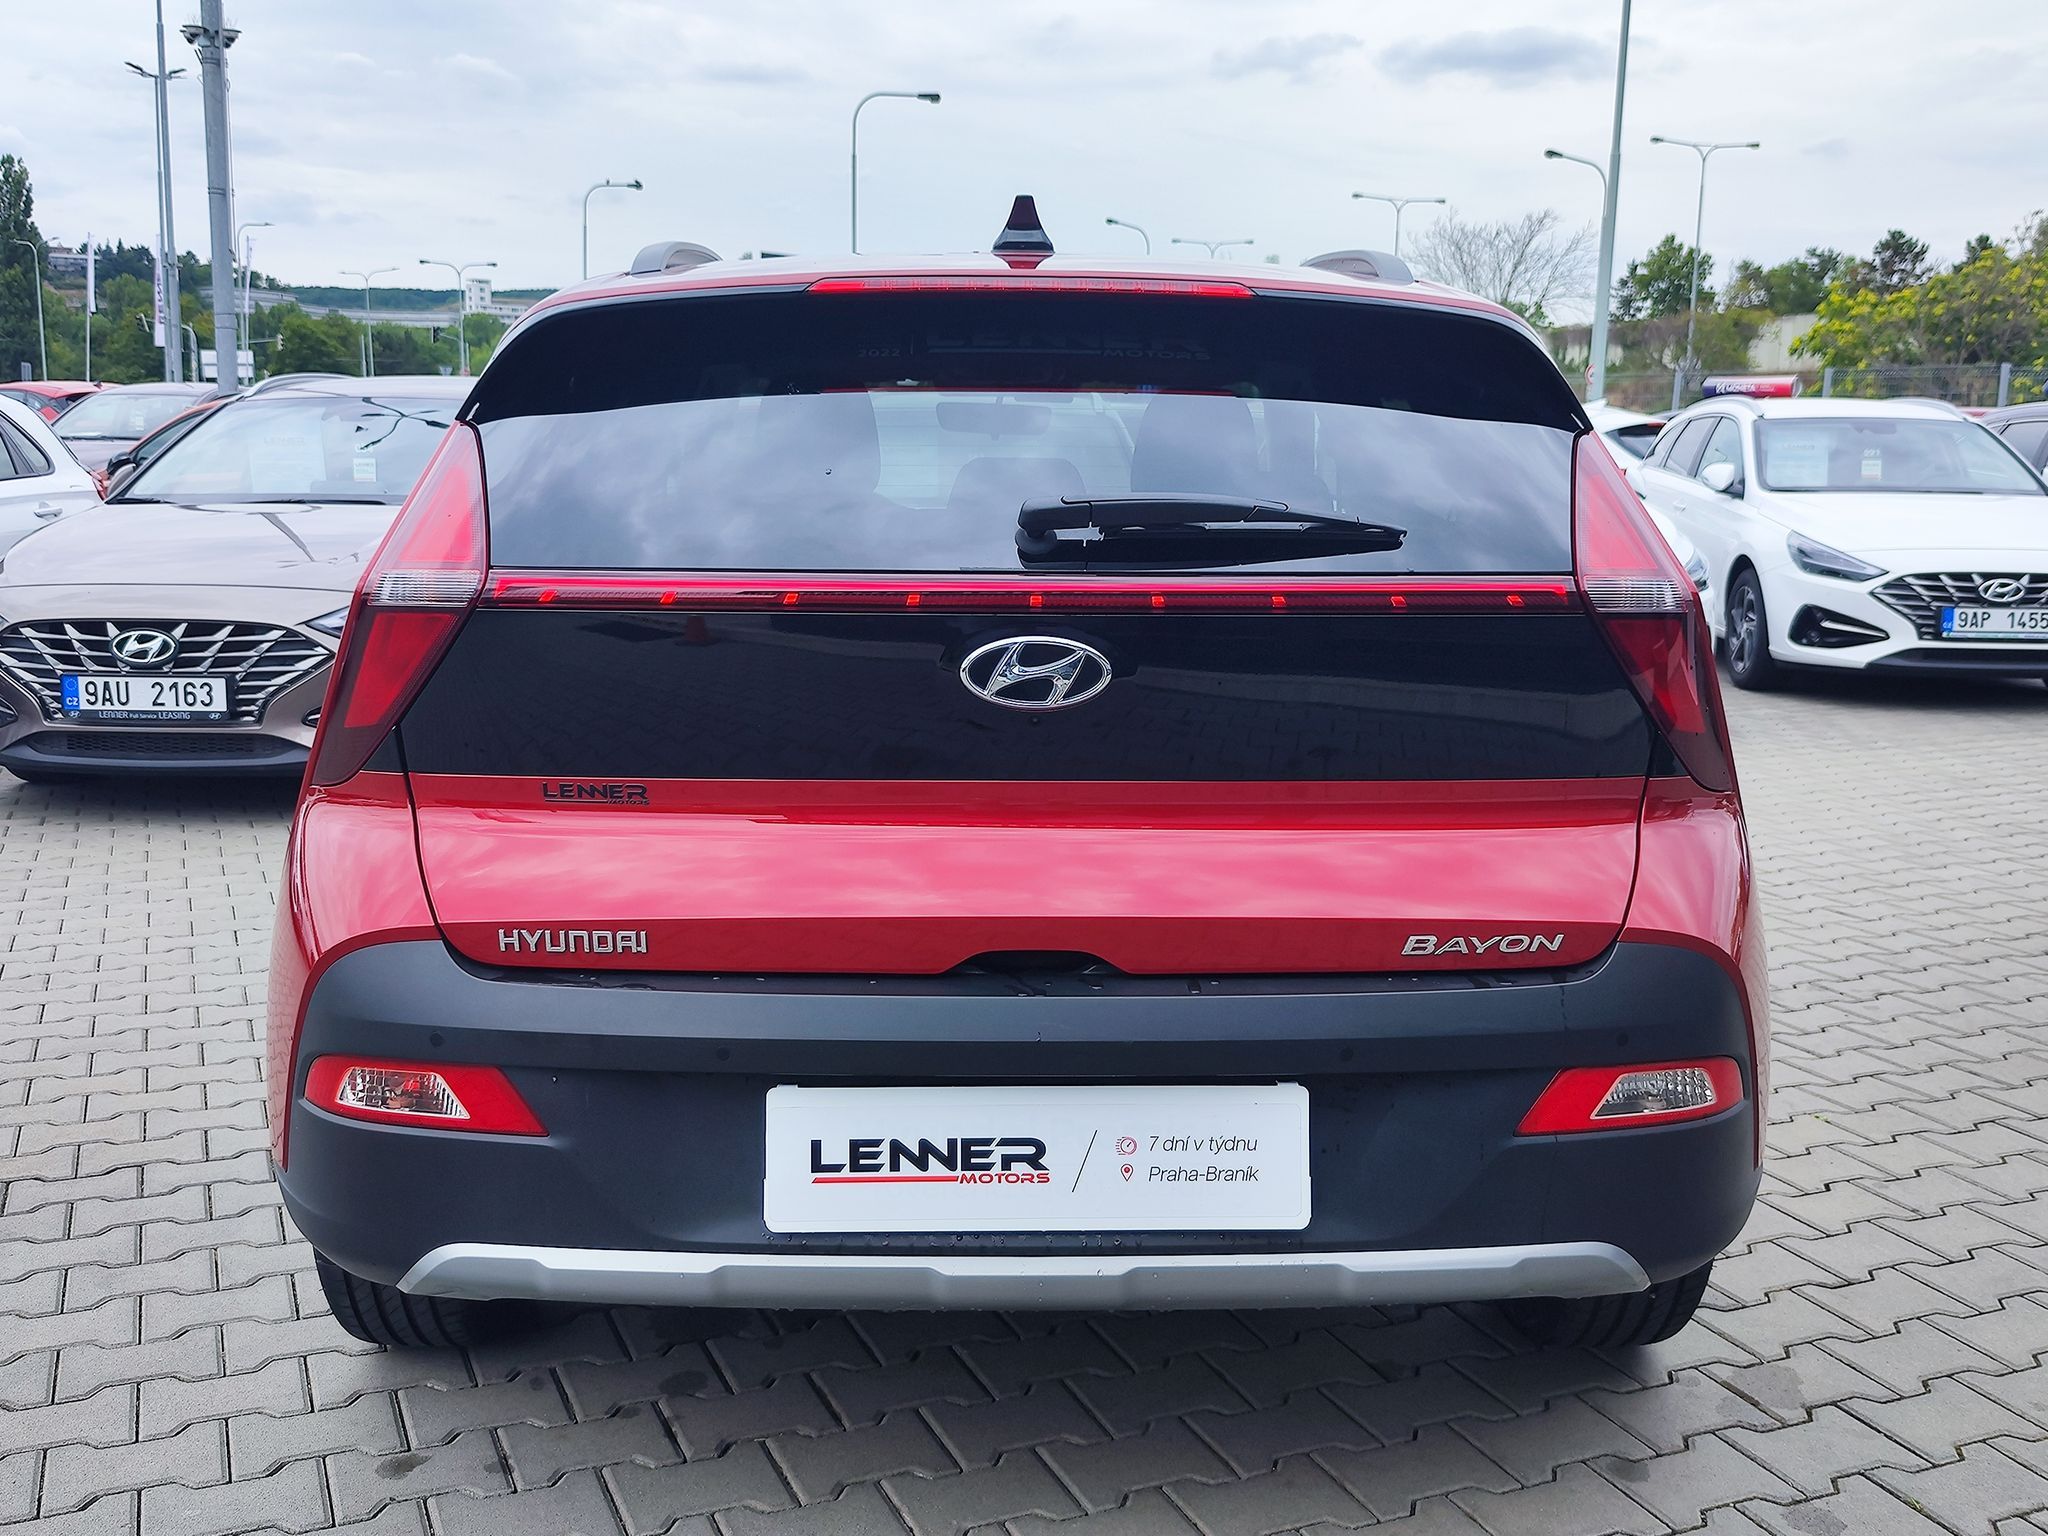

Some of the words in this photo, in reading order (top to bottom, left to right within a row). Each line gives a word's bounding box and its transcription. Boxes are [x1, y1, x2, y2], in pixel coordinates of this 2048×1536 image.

[1103, 349, 1211, 361] MOTORS
[1958, 611, 1991, 629] 9AP
[66, 697, 79, 706] CZ
[84, 680, 130, 707] 9AU
[151, 681, 214, 708] 2163
[99, 710, 128, 719] LENNER
[158, 711, 191, 720] LEASING
[542, 782, 649, 800] LENNER
[498, 928, 648, 953] HYUNDAI
[1401, 934, 1565, 956] BAYON
[1149, 1135, 1160, 1152] 7
[1162, 1135, 1191, 1152] dní
[1193, 1139, 1204, 1152] v
[1208, 1135, 1258, 1155] týdnu
[810, 1137, 1050, 1173] LENNER
[959, 1172, 1050, 1184] MOTORS
[1148, 1165, 1260, 1182] Praha-Braník
